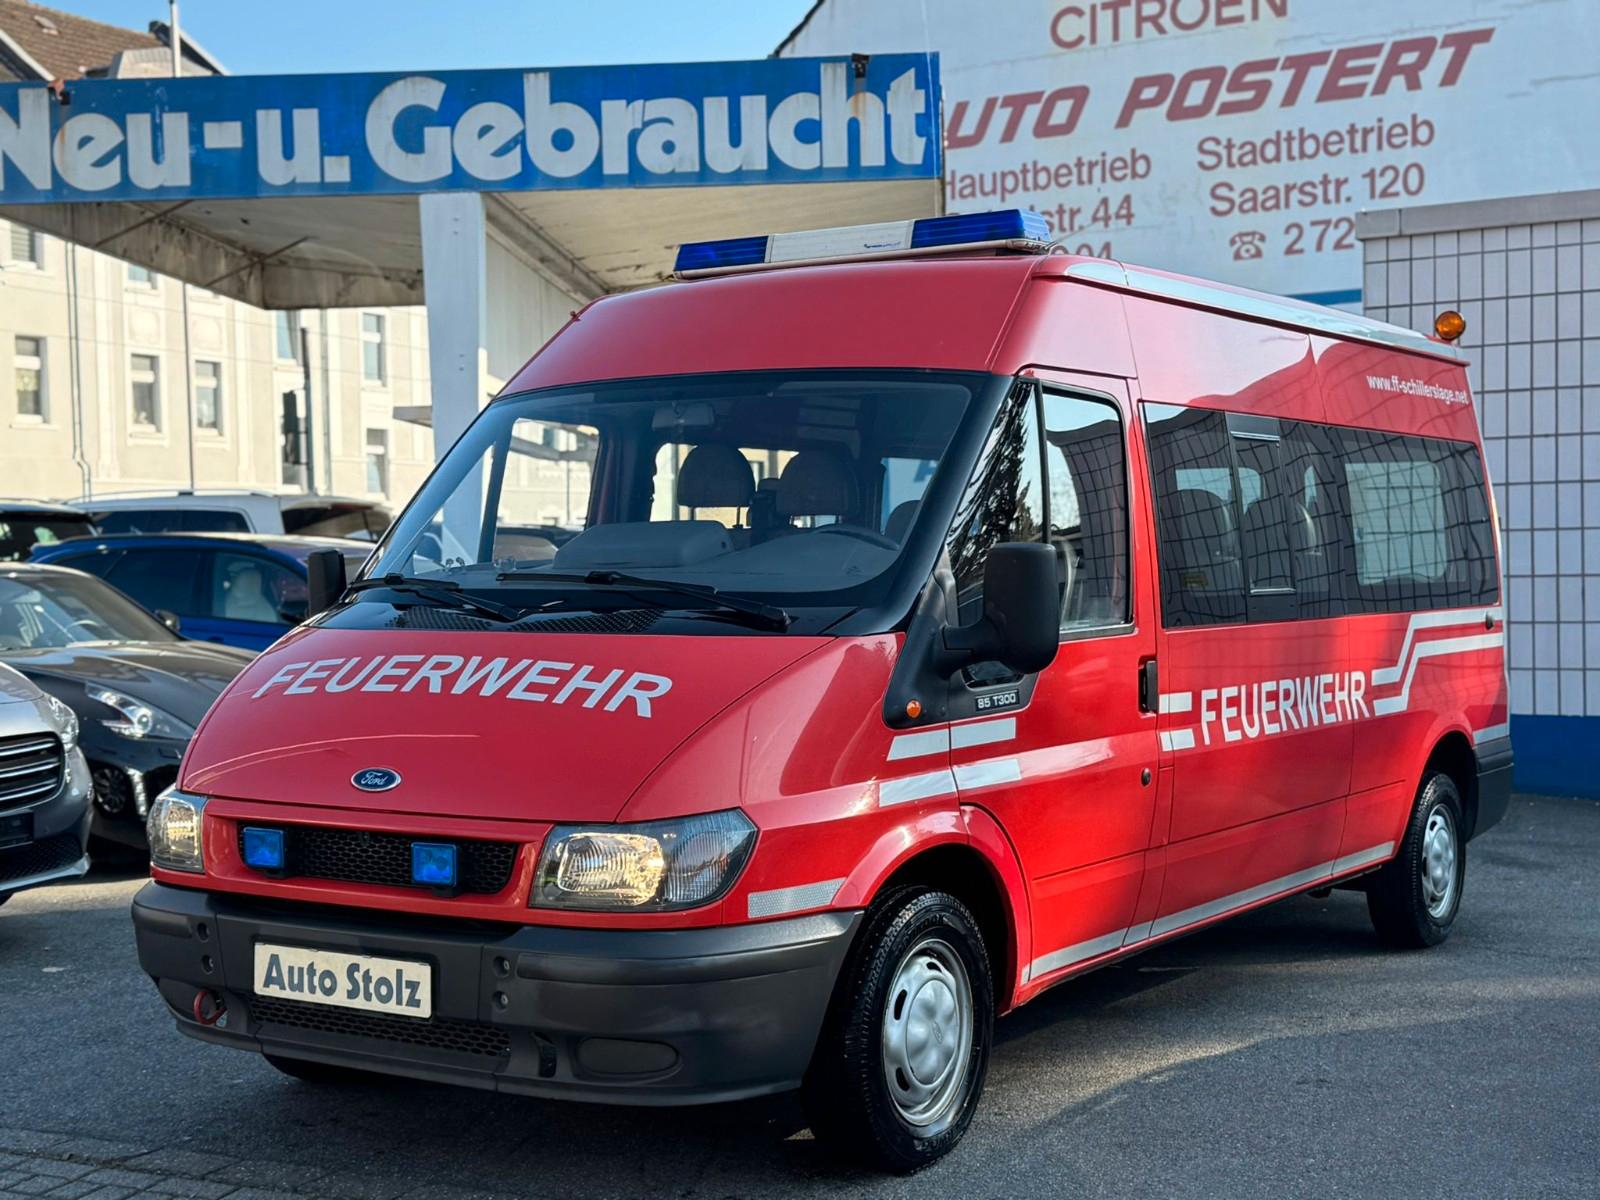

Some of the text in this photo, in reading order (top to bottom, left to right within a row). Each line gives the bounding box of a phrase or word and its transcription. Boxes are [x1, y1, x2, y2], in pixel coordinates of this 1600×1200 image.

[1114, 27, 1496, 129] POSTERT
[365, 62, 927, 183] Gebraucht
[1197, 113, 1435, 171] Stadtbetrieb
[1091, 193, 1135, 229] 44
[1209, 162, 1425, 217] Saarstr. 120
[251, 654, 673, 718] FEUERWEHR
[993, 693, 1016, 706] T300
[1200, 670, 1371, 745] FEUERWEHR
[360, 771, 389, 786] Ford
[263, 953, 422, 1009] Auto Stolz
